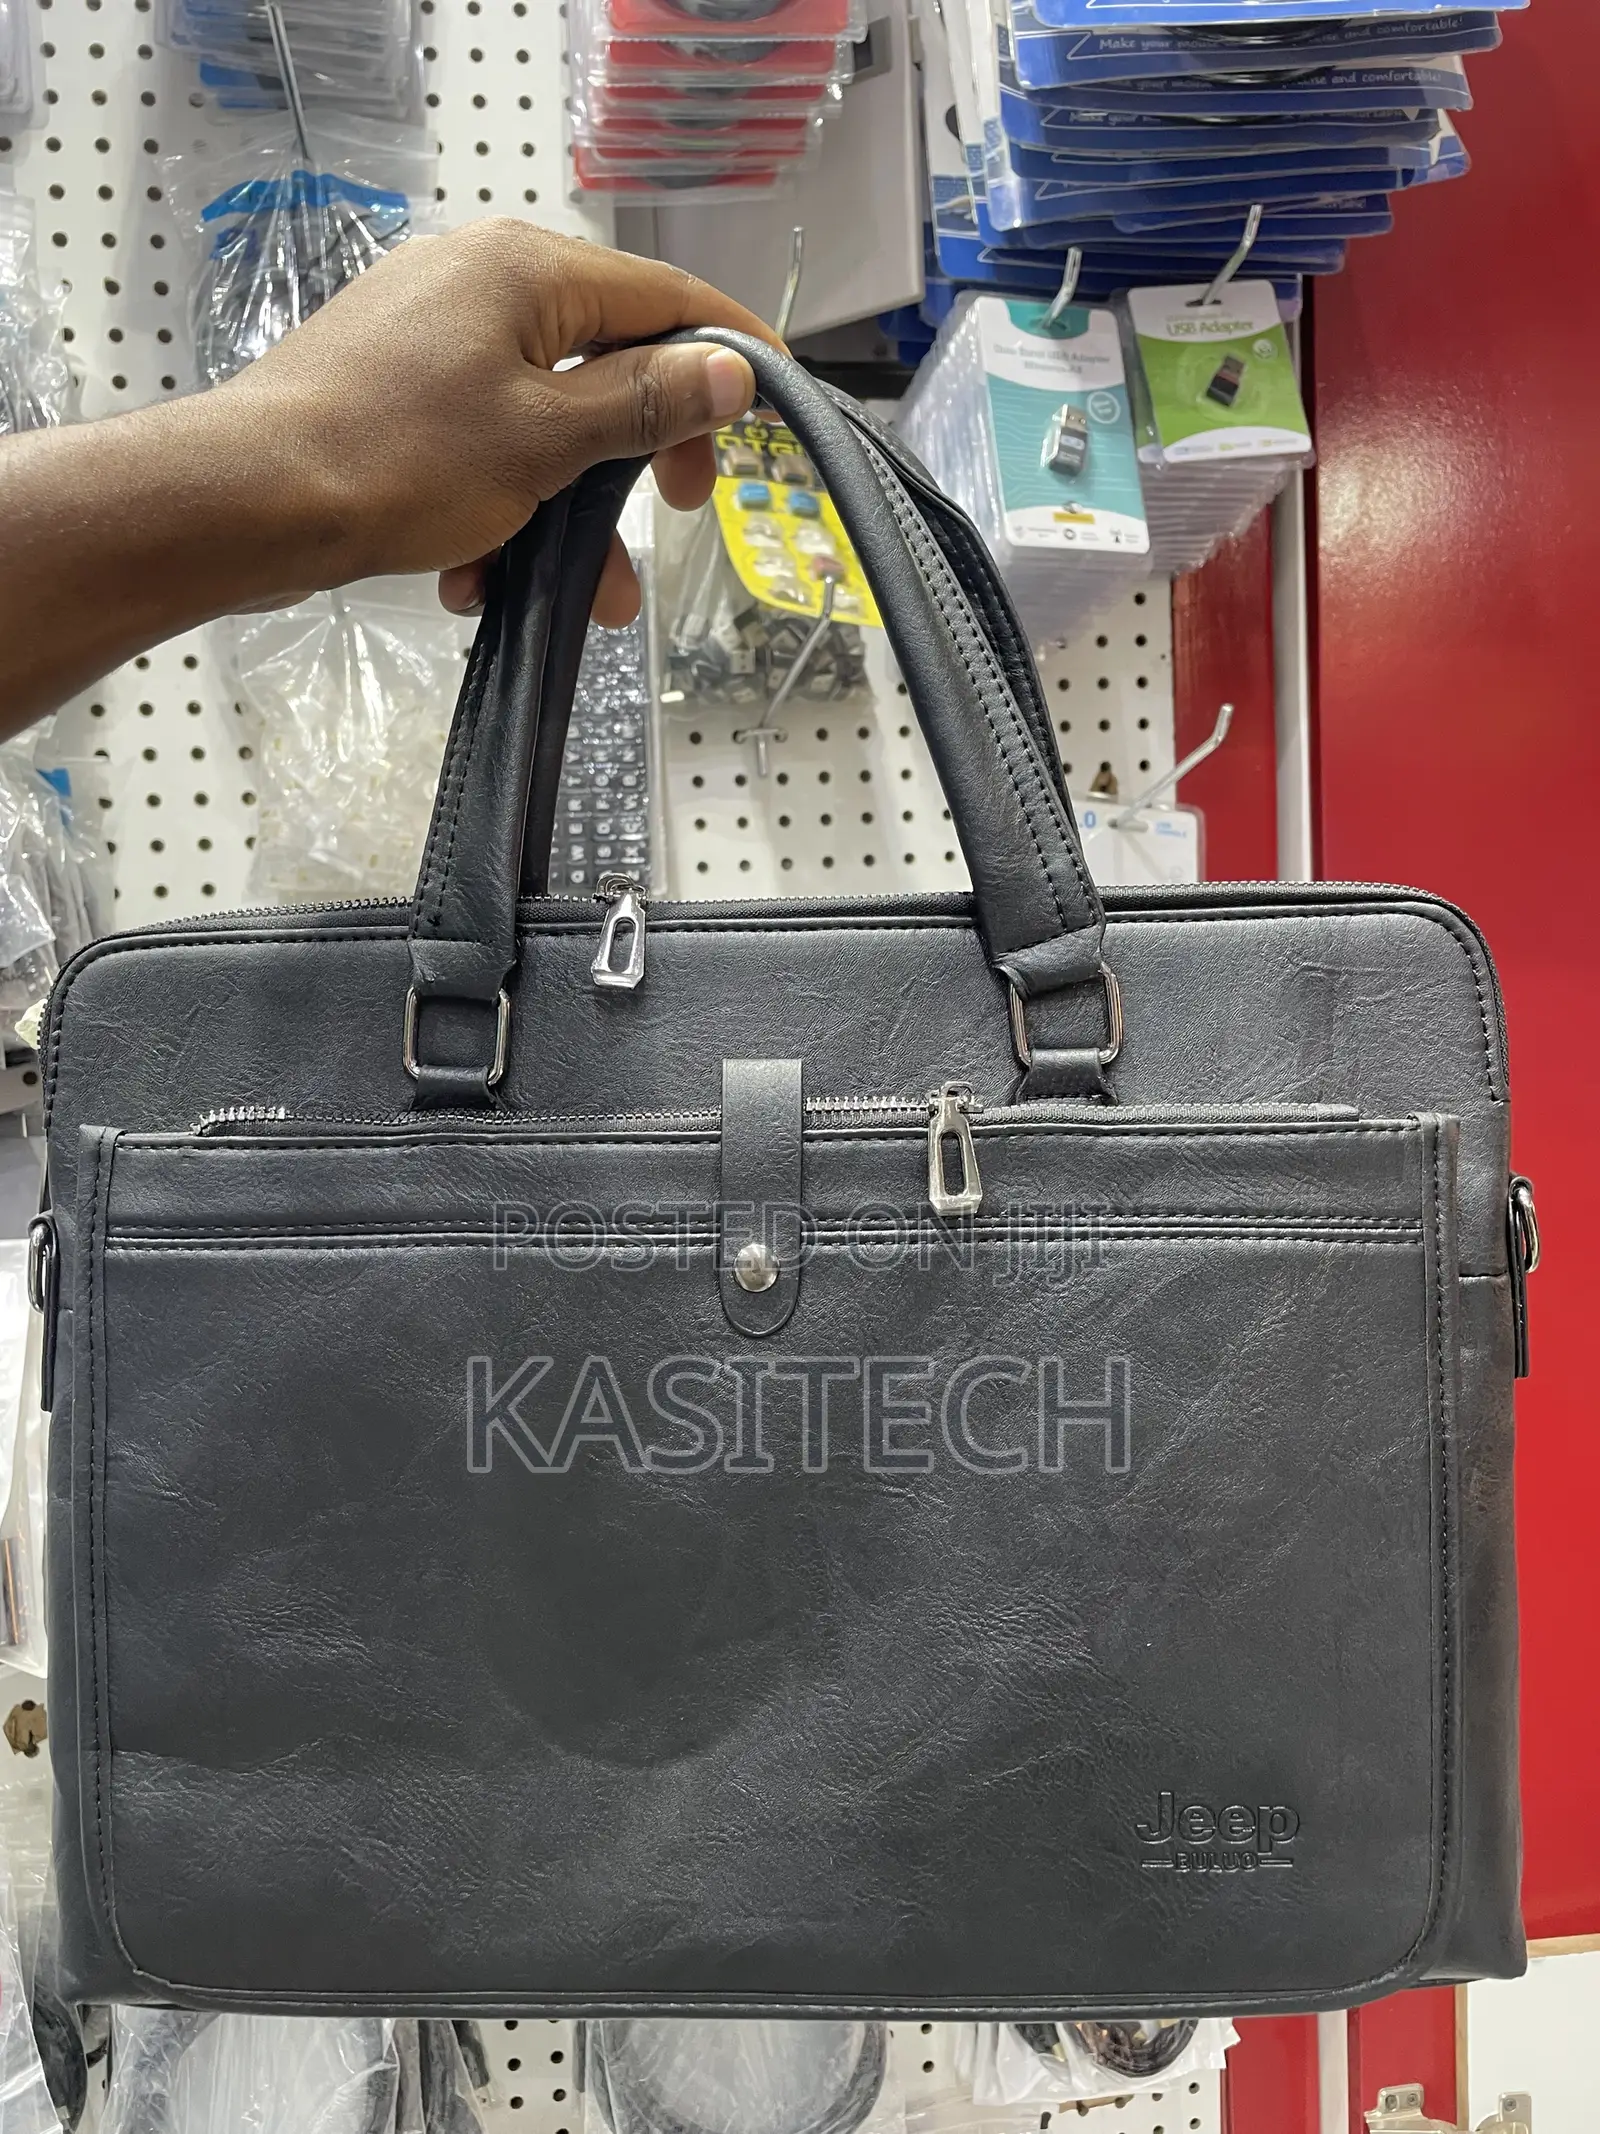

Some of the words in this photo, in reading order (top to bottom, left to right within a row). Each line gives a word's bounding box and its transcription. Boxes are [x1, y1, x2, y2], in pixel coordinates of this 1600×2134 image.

[1099, 37, 1136, 49] Make
[1199, 320, 1254, 335] Adapter
[1135, 1790, 1300, 1856] Jeep
